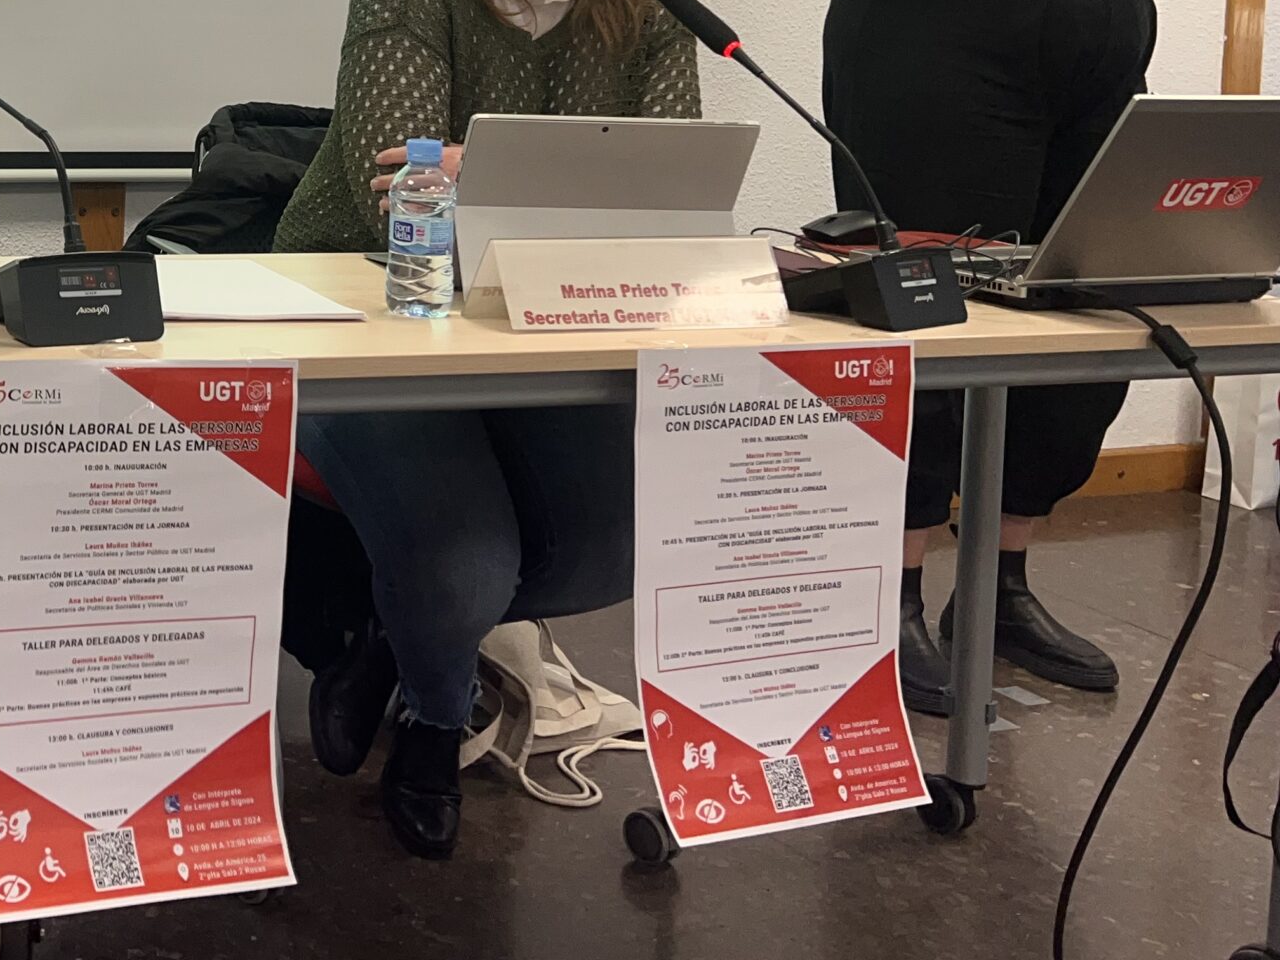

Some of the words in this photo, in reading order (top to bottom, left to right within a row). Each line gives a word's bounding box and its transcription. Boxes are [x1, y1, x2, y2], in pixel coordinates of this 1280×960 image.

[1162, 180, 1230, 207] UGT
[561, 284, 617, 299] Marina
[620, 283, 668, 298] Prieto
[524, 310, 609, 325] Secretaria
[614, 309, 672, 324] General
[657, 363, 679, 389] 25
[835, 359, 870, 379] UGT
[868, 378, 893, 386] Madrid
[200, 381, 244, 402] UGT
[241, 403, 269, 412] Madrid
[664, 401, 726, 417] INCLUSIÓN
[729, 398, 780, 413] LABORAL
[783, 397, 799, 410] DE
[801, 396, 823, 408] LAS
[826, 394, 885, 407] PERSONAS
[70, 423, 133, 435] LABORAL
[138, 423, 155, 434] DE
[160, 423, 185, 434] LAS
[190, 421, 262, 434] PERSONAS
[666, 421, 690, 432] CON
[693, 415, 776, 431] DISCAPACIDAD
[780, 414, 794, 425] EN
[797, 412, 820, 424] LAS
[822, 409, 883, 423] EMPRESAS
[24, 440, 128, 453] DISCAPACIDAD
[132, 440, 150, 452] EN
[155, 440, 181, 452] LAS
[186, 439, 259, 452] EMPRESAS
[113, 462, 167, 471] INAUGURACIÓN
[698, 593, 725, 603] TALLER
[727, 590, 746, 601] PARA
[748, 586, 791, 599] DELEGADOS
[800, 581, 842, 593] DELEGADAS
[22, 639, 56, 651] TALLER
[59, 638, 84, 648] PARA
[86, 634, 141, 647] DELEGADOS
[151, 631, 205, 642] DELEGADAS
[84, 807, 128, 819] INSCRÍBETE
[210, 820, 231, 829] ABRIL
[233, 818, 241, 826] DE
[244, 816, 261, 824] 2024
